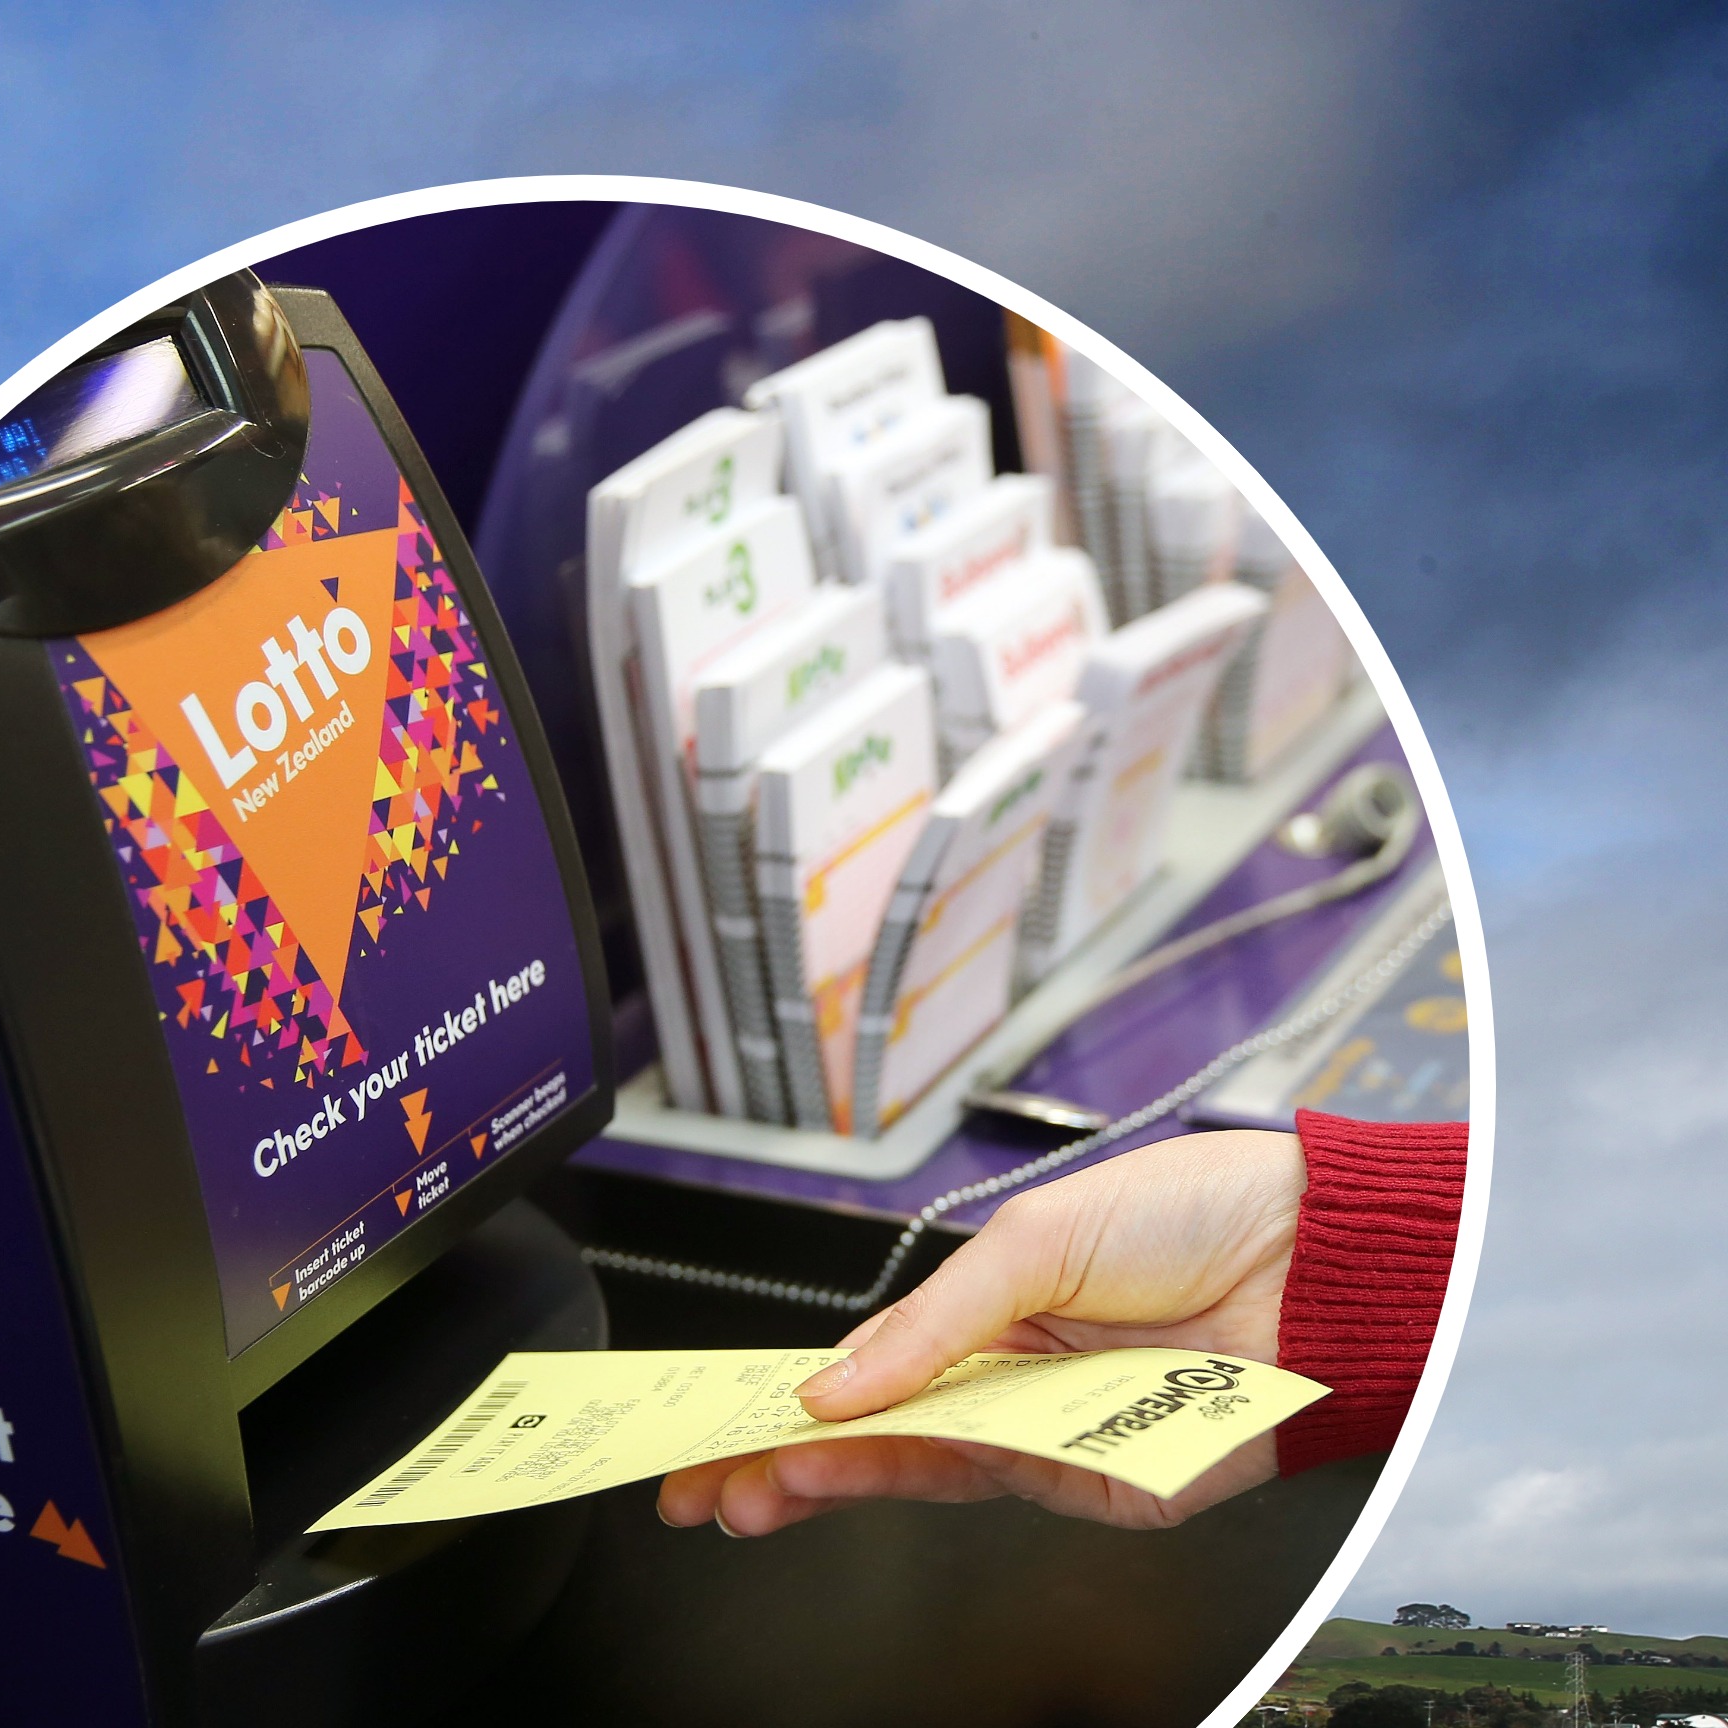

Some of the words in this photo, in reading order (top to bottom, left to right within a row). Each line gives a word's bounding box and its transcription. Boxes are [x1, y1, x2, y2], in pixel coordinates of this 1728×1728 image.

[179, 607, 371, 790] Lotto
[232, 772, 279, 823] New
[276, 699, 356, 783] Zealand
[253, 1094, 347, 1178] Check
[348, 1050, 410, 1122] your
[414, 991, 487, 1066] ticket
[489, 959, 545, 1015] here
[491, 1094, 534, 1135] Scanner
[416, 1161, 448, 1191] Move
[417, 1175, 450, 1209] ticket
[294, 1248, 330, 1284] Insert
[331, 1220, 365, 1256] ticket
[298, 1257, 348, 1302] barcode
[350, 1243, 366, 1262] up
[748, 1407, 770, 1419] 12
[770, 1382, 791, 1399] 09
[1060, 1359, 1246, 1455] POWERBALL
